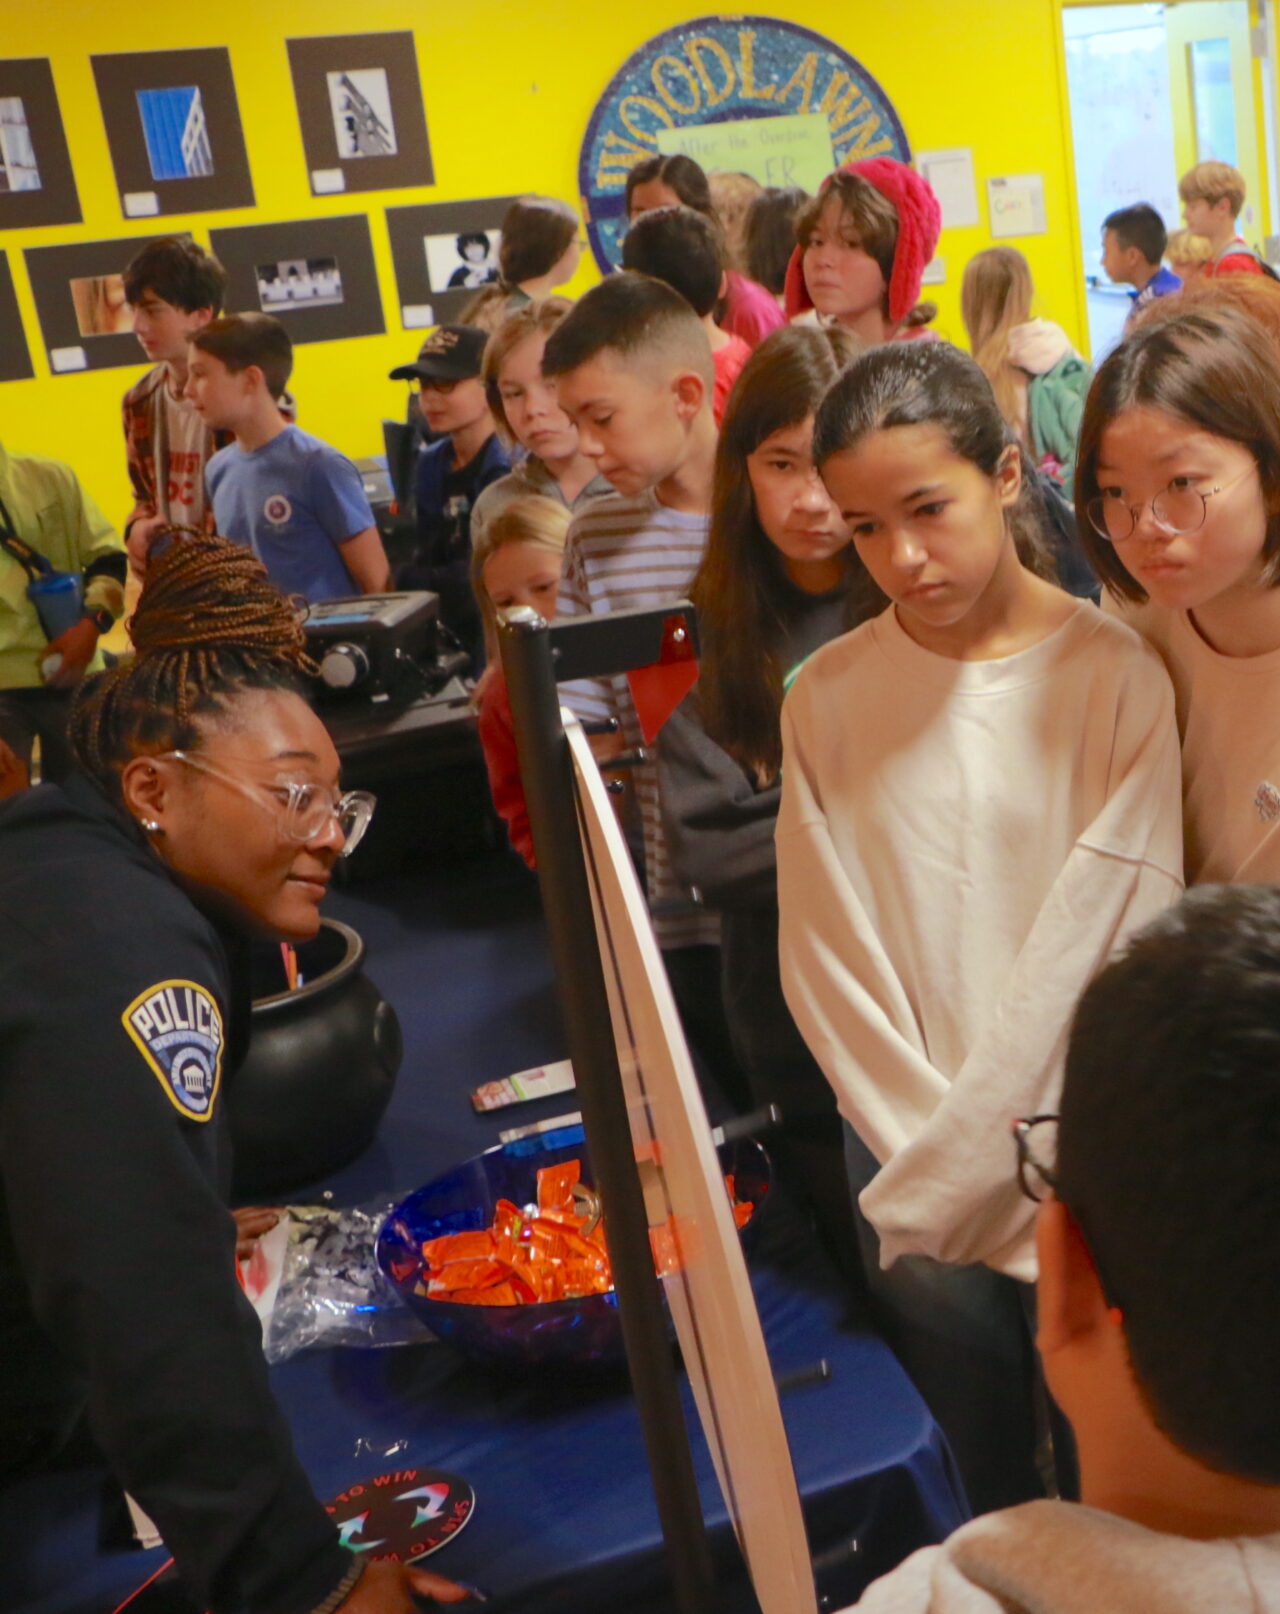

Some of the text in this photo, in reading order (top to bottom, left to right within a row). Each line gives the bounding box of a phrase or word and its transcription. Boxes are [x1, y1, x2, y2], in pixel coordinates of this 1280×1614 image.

[596, 31, 894, 189] WOODLAWN
[130, 987, 220, 1045] POLICE
[373, 1470, 417, 1488] WIN
[440, 1499, 470, 1533] SPIN
